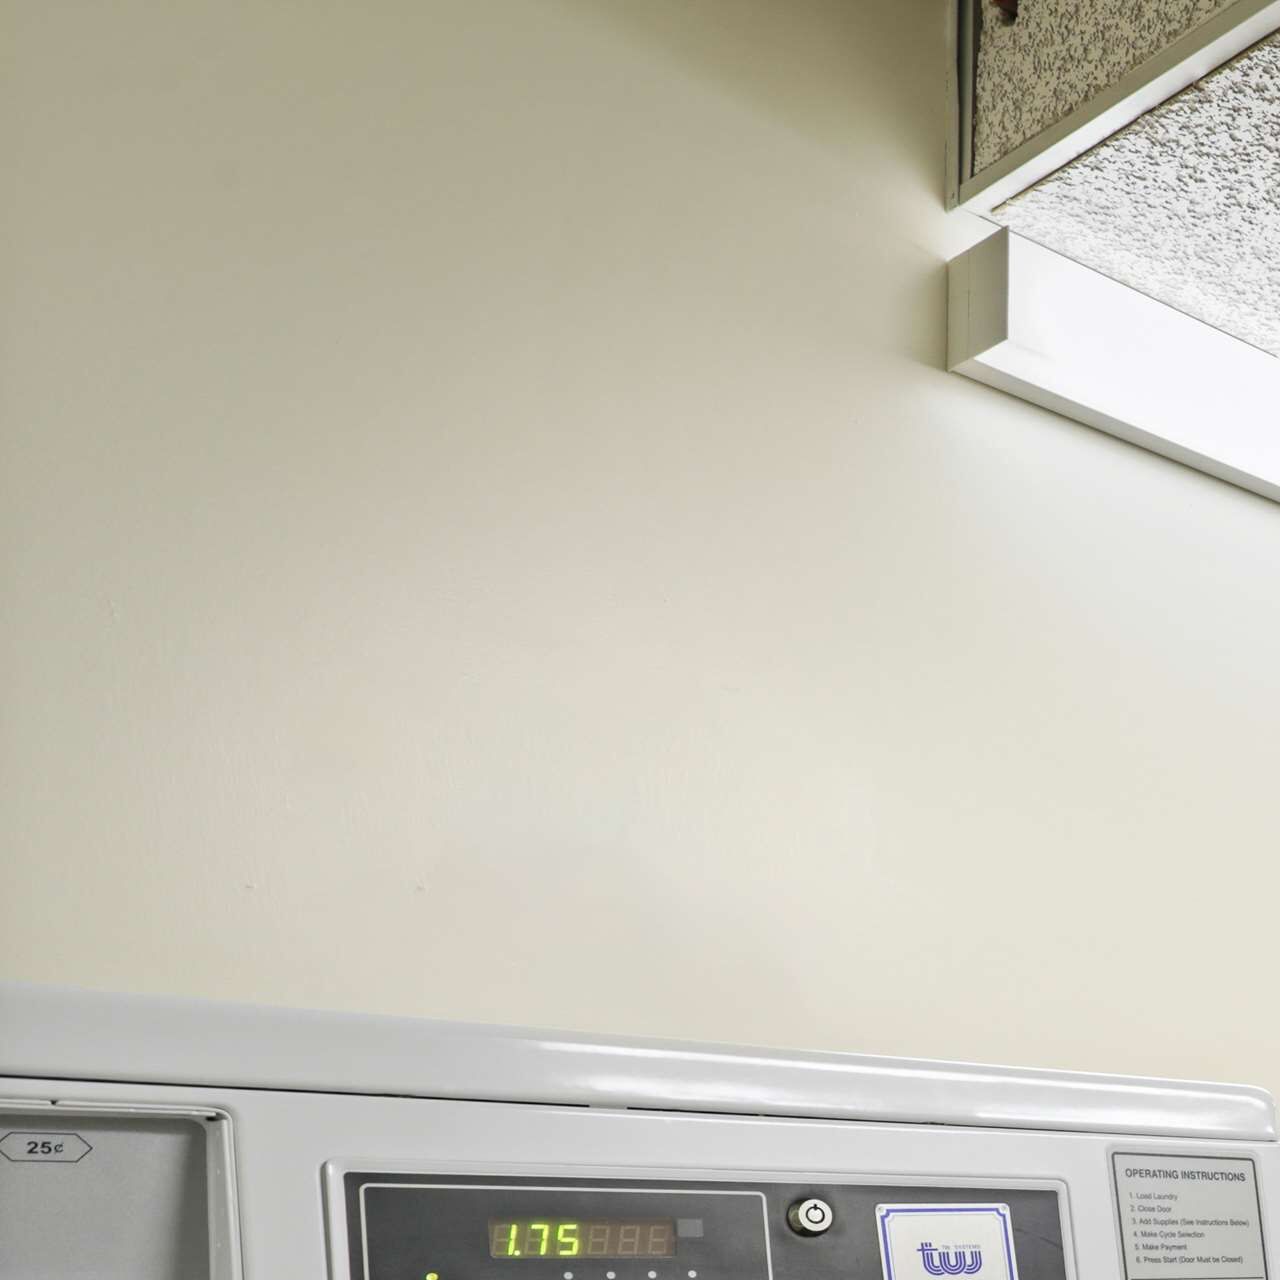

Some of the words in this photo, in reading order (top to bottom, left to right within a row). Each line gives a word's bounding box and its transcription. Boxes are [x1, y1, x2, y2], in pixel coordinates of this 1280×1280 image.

[1125, 1168, 1179, 1179] OPERATING
[1181, 1170, 1246, 1181] INSTRUCTIONS
[1136, 1192, 1152, 1200] Load
[1153, 1192, 1178, 1201] Laundry
[1157, 1205, 1172, 1213] Door
[1139, 1217, 1152, 1225] Add
[1153, 1217, 1179, 1226] Supplies
[1196, 1218, 1228, 1226] Instructions
[1229, 1218, 1249, 1227] Below)
[1140, 1230, 1158, 1238] Make
[1159, 1230, 1176, 1239] Cycle
[1177, 1230, 1205, 1238] Selection
[507, 1223, 579, 1256] 1.75
[1160, 1243, 1187, 1251] Payment
[1143, 1255, 1162, 1263] Press
[1163, 1255, 1178, 1263] Start
[1179, 1255, 1195, 1264] (Door
[1196, 1255, 1212, 1263] Must
[1221, 1255, 1243, 1264] Closed)
